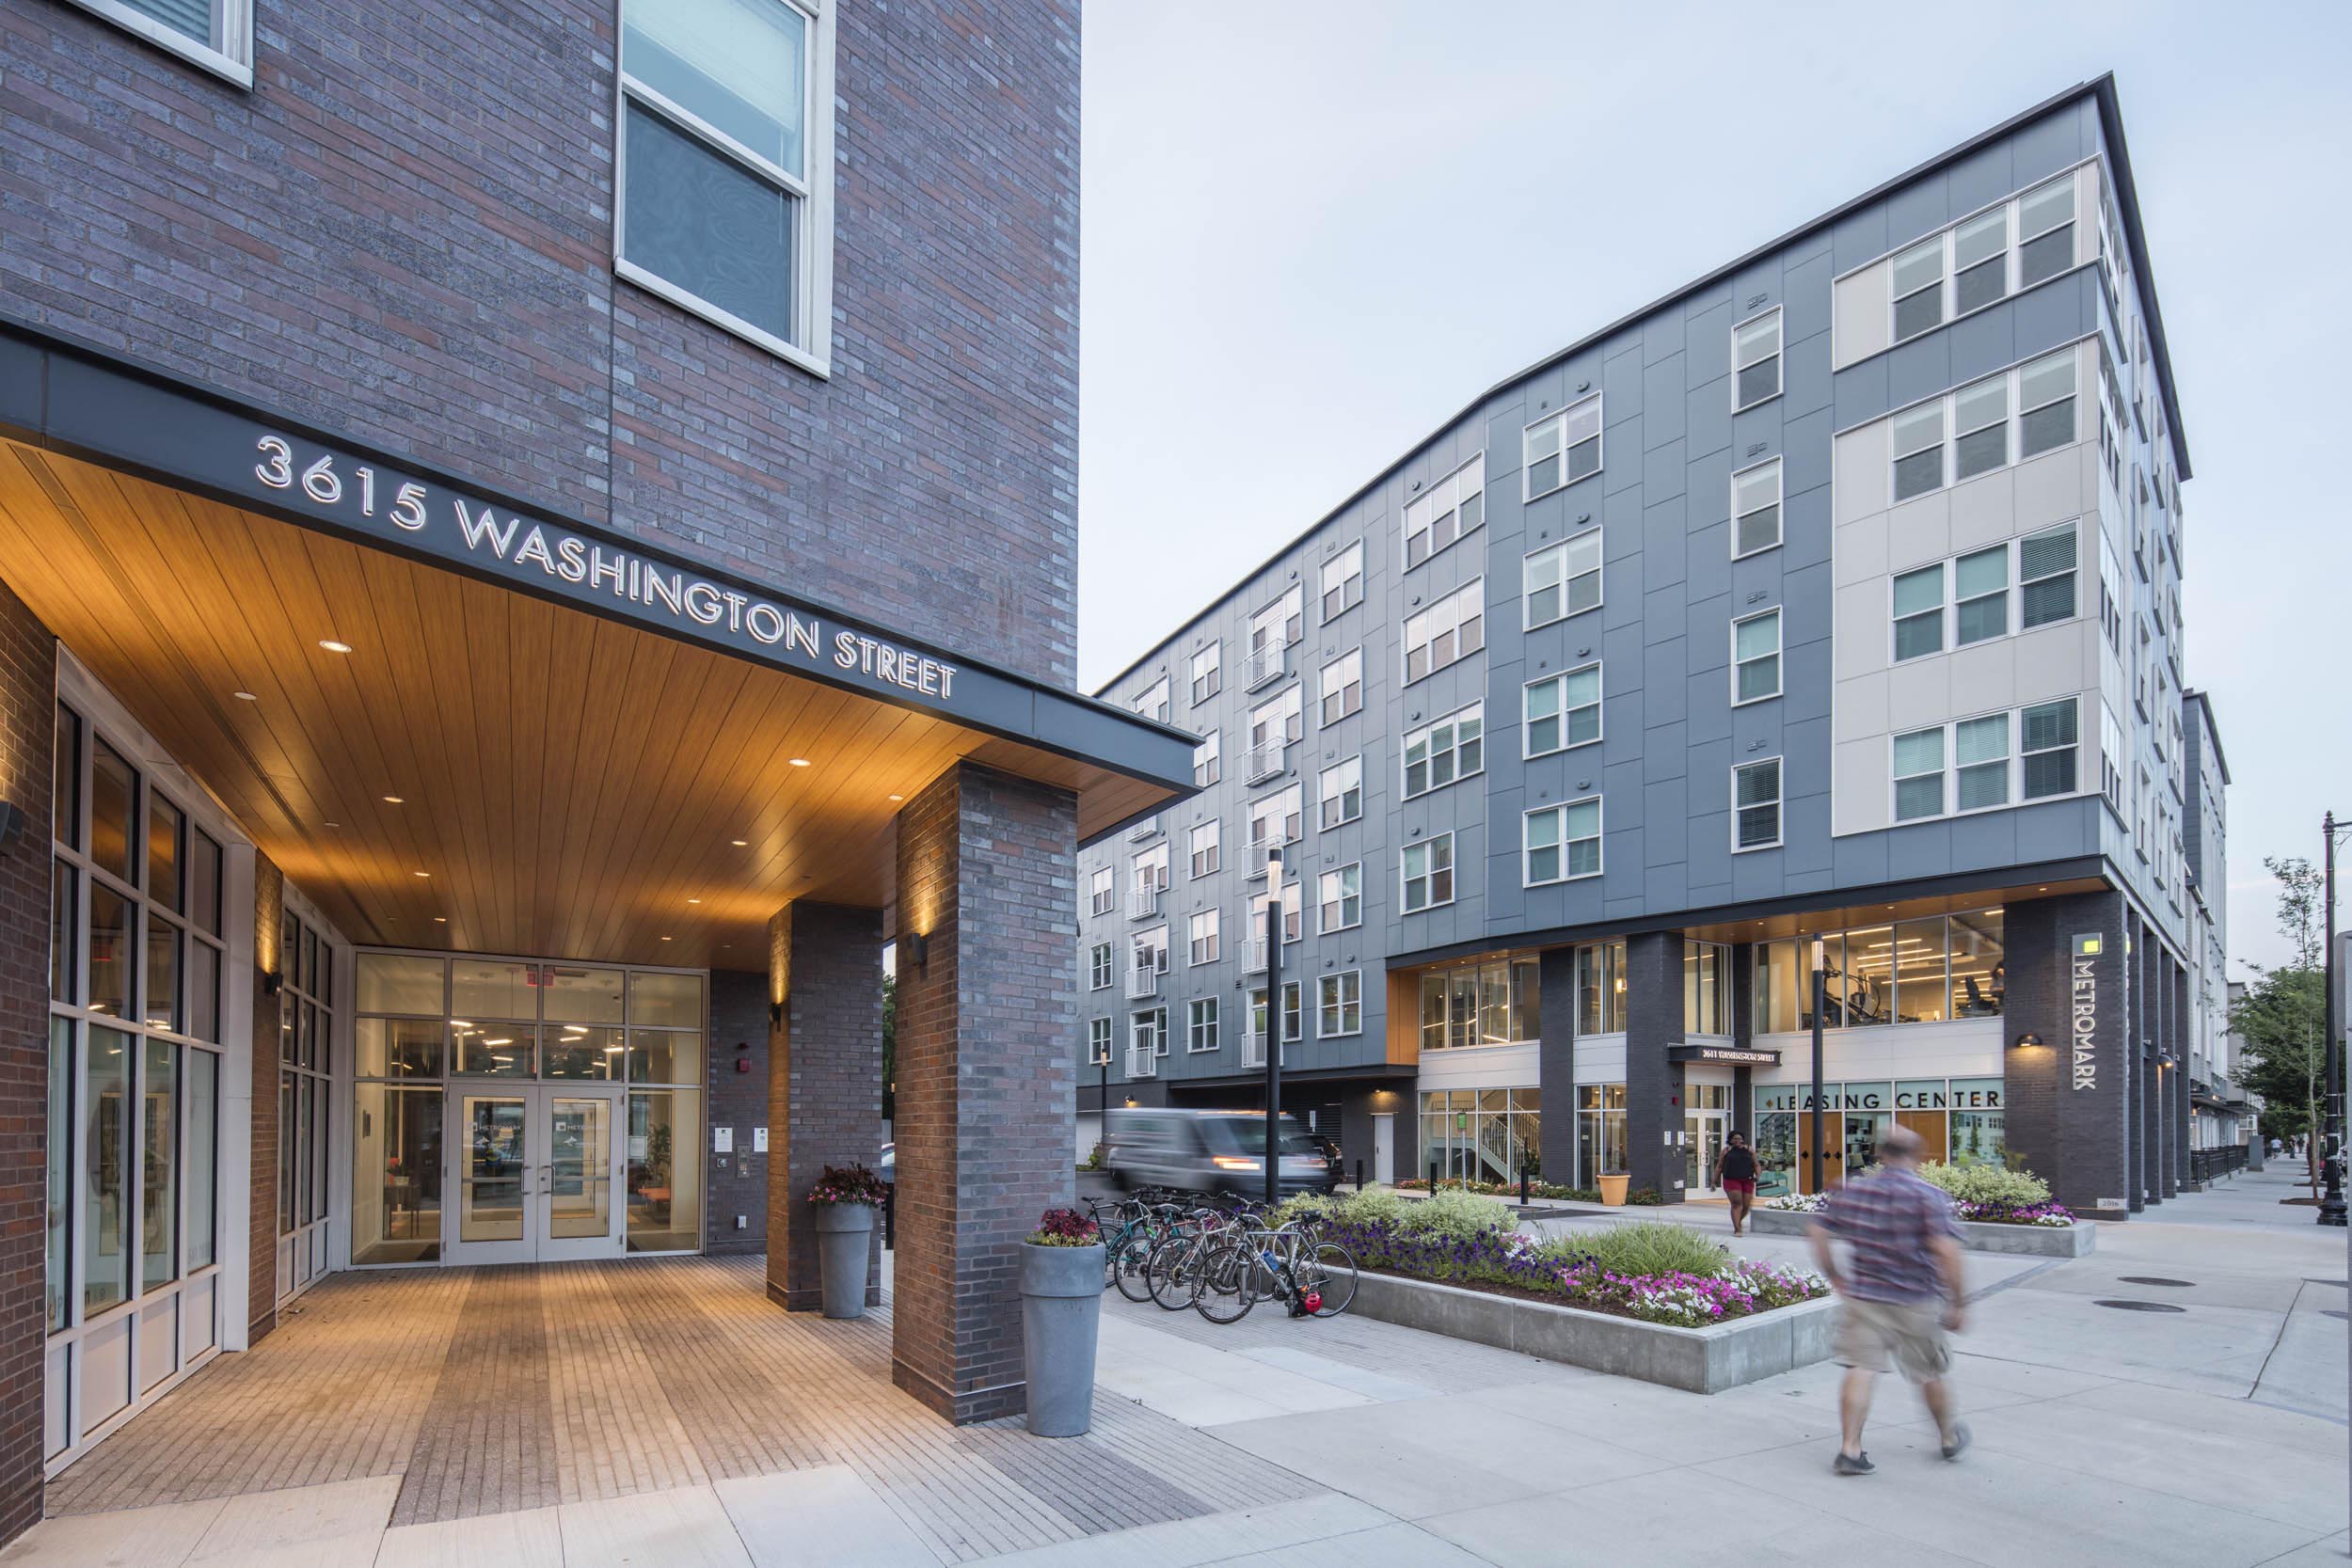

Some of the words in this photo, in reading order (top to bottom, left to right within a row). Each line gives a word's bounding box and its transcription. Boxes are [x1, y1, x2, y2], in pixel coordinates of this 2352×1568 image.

[256, 435, 427, 530] 3615
[453, 499, 820, 658] WASHINGTON
[834, 631, 957, 699] STREET
[1718, 1051, 1756, 1061] WASHINGTON
[1756, 1053, 1775, 1062] STREET
[2074, 960, 2096, 1090] METROMARK
[1777, 1094, 1880, 1110] LEASING
[1897, 1090, 2000, 1108] CENTER
